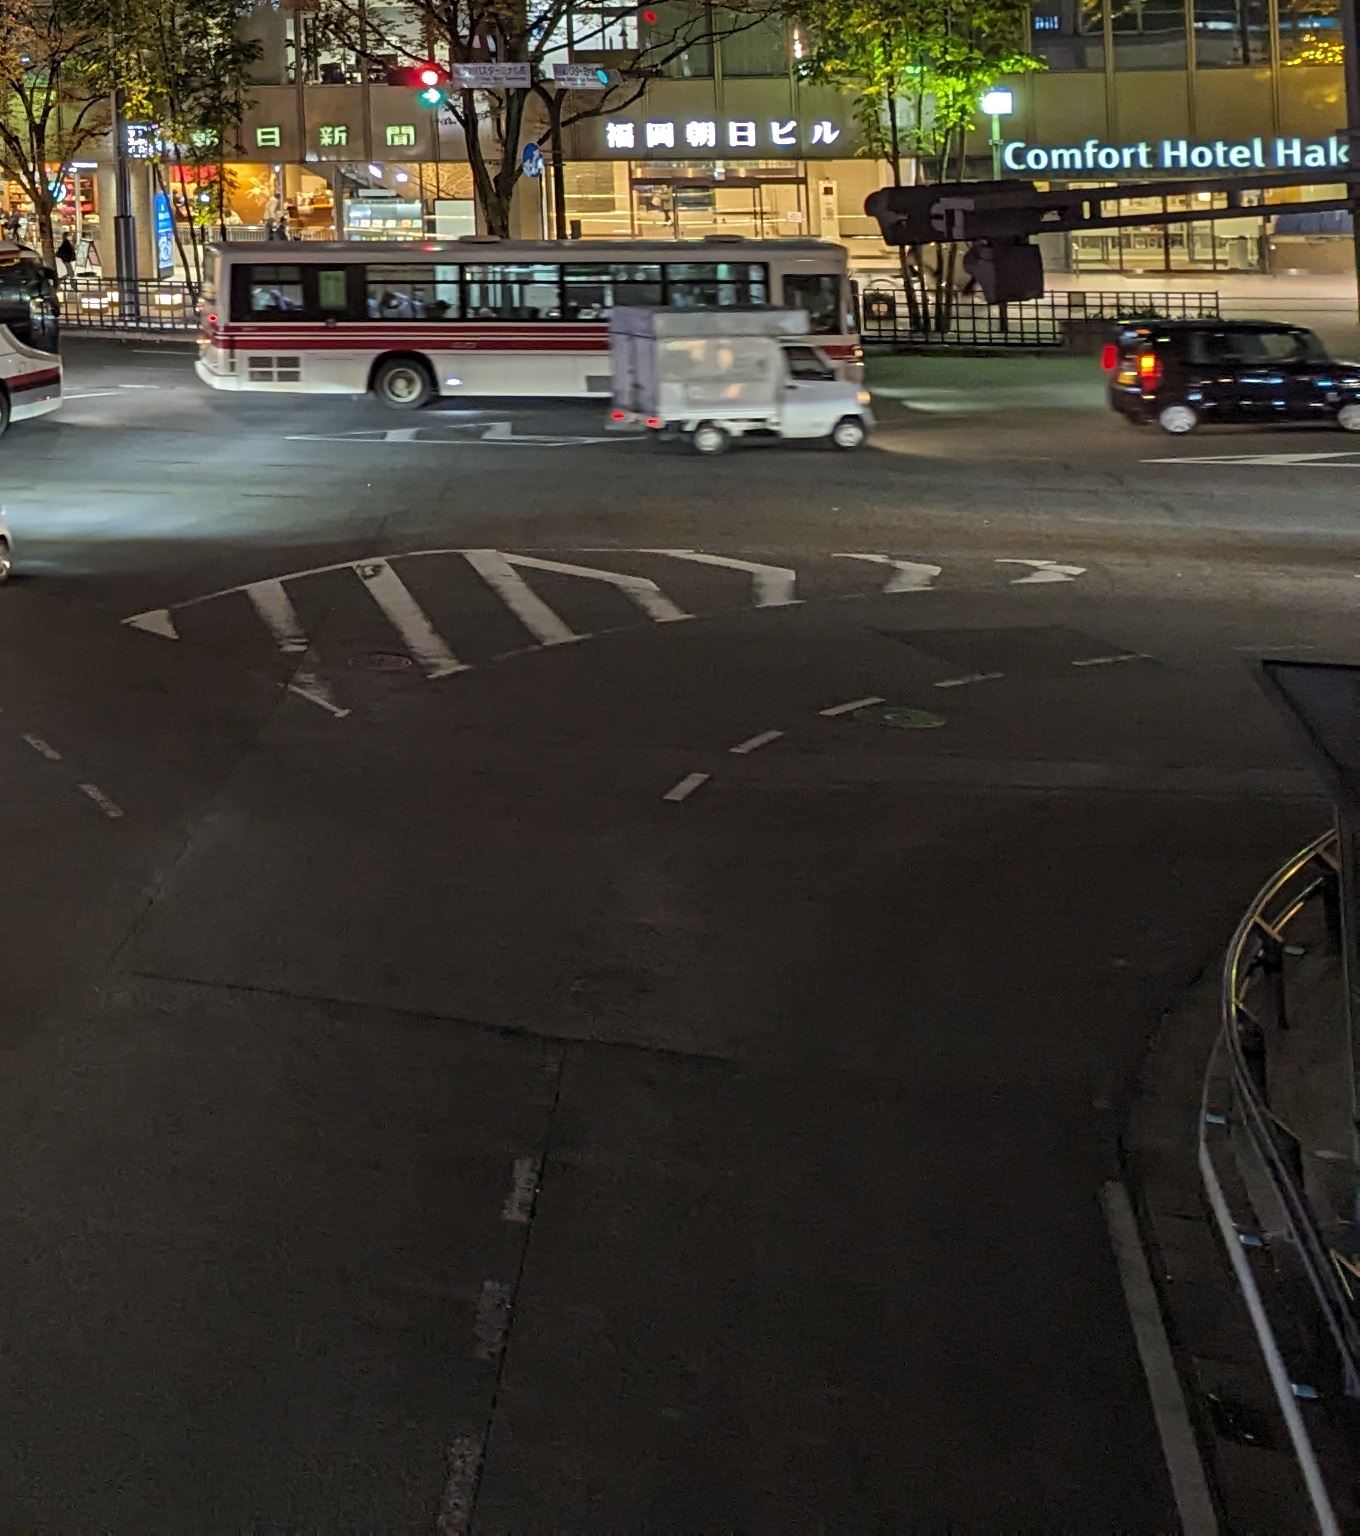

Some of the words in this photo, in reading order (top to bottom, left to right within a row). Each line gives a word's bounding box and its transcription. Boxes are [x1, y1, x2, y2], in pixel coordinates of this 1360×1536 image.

[606, 121, 840, 148] 福岡朝日ビル
[1004, 139, 1153, 170] Comfort
[1162, 137, 1266, 168] Hotel
